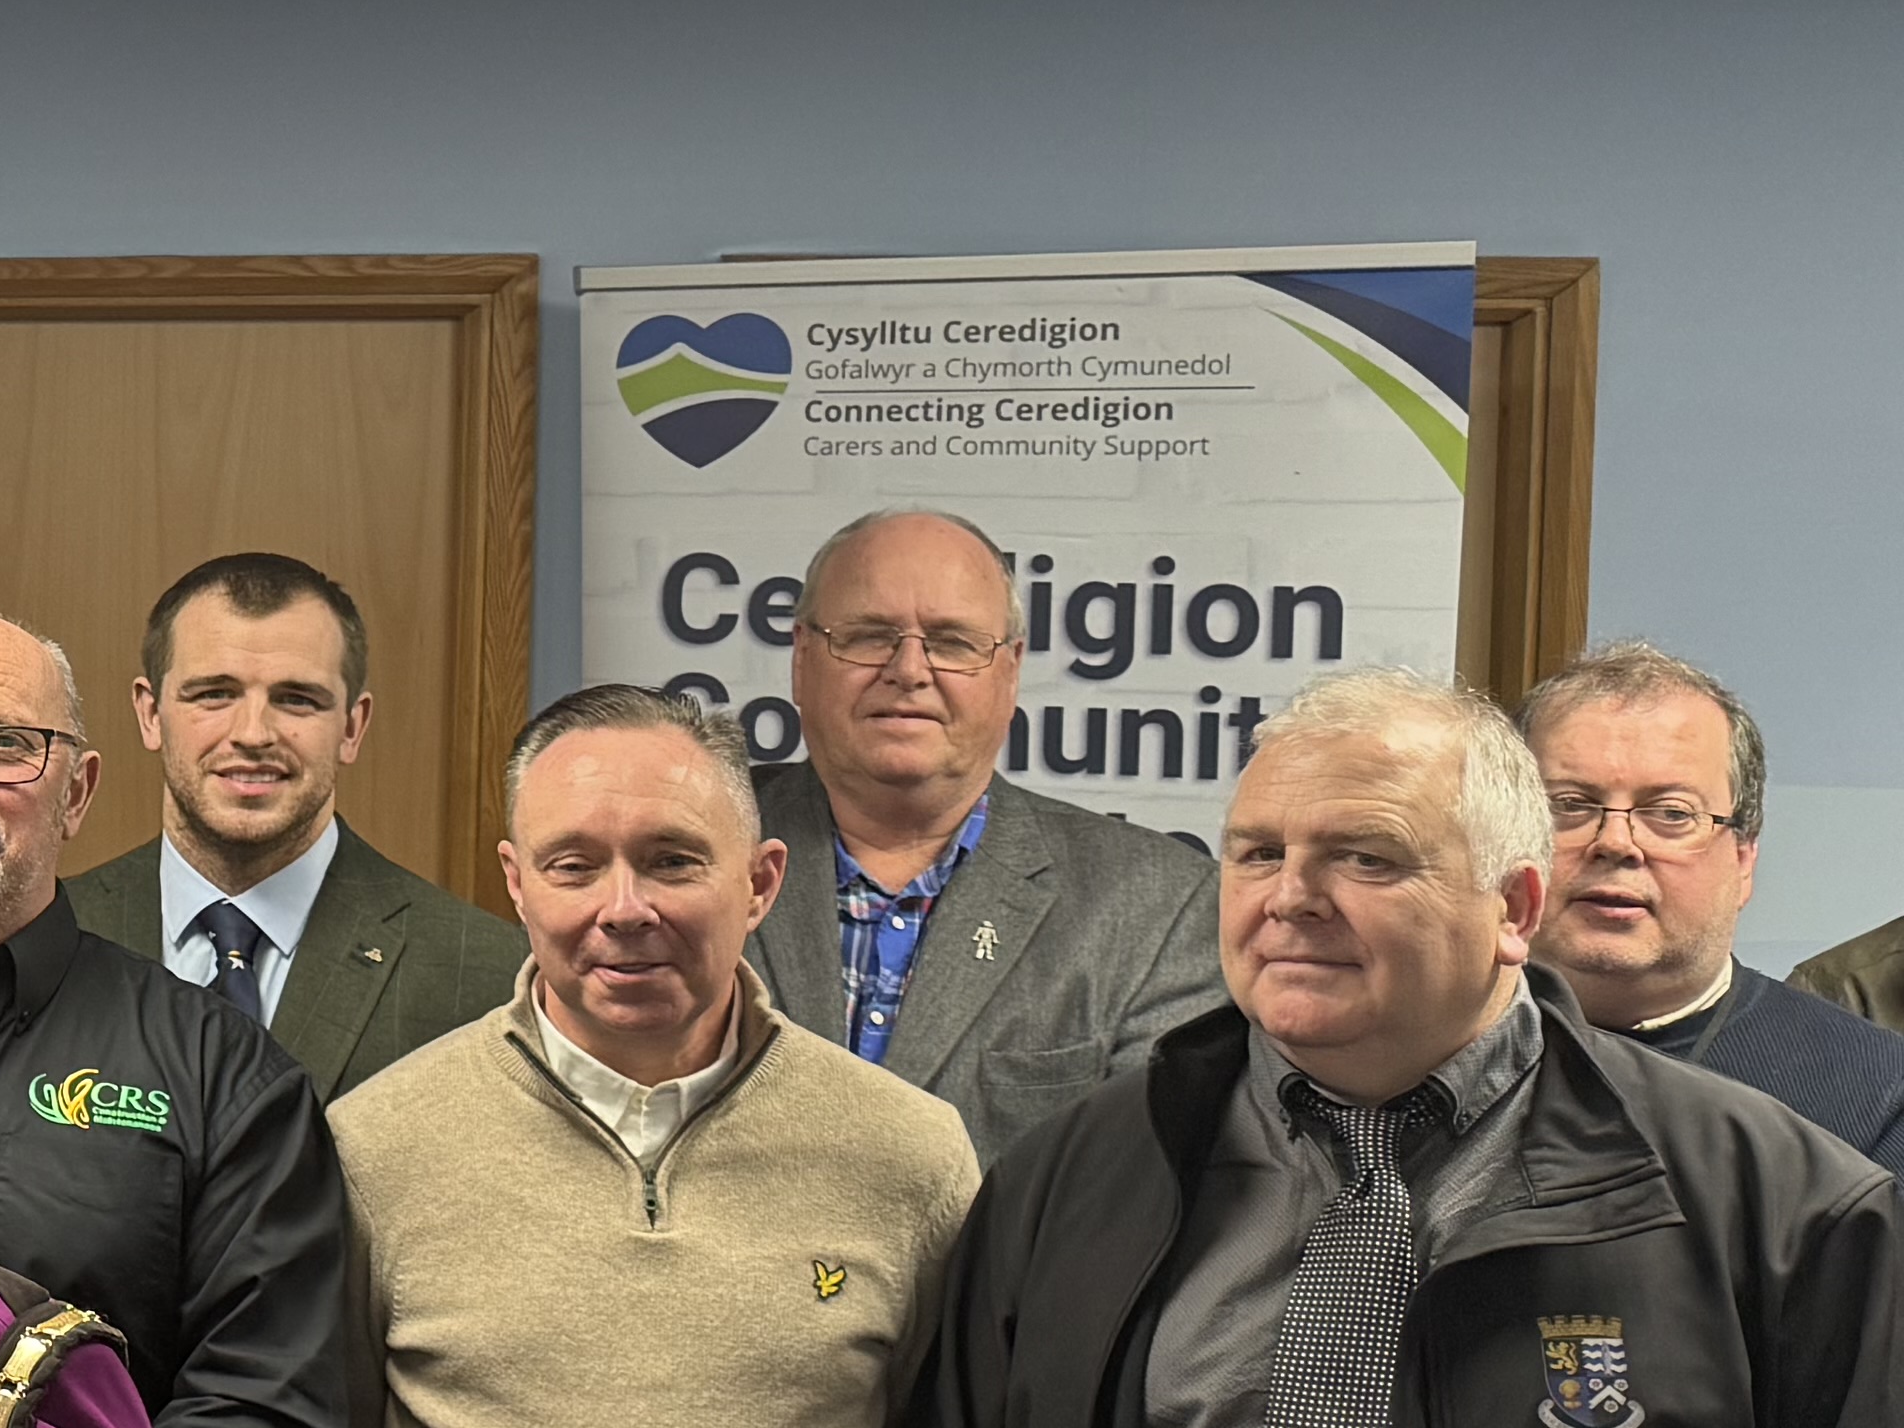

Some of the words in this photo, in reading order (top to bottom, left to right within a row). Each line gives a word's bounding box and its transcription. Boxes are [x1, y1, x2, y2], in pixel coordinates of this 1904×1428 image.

[806, 320, 932, 353] Cysylltu
[943, 316, 1120, 349] Ceredigion
[804, 358, 916, 384] Gofalwyr
[922, 362, 937, 378] a
[944, 355, 1073, 384] Chymorth
[1081, 352, 1231, 383] Cymunedol
[804, 397, 986, 429] Connecting
[995, 395, 1174, 429] Ceredigion
[803, 435, 883, 457] Carers
[890, 435, 937, 456] and
[945, 435, 1097, 462] Community
[1103, 434, 1210, 462] Support
[662, 551, 1344, 680] Ceigion
[663, 672, 1268, 780] ounit
[90, 1082, 171, 1116] CRS
